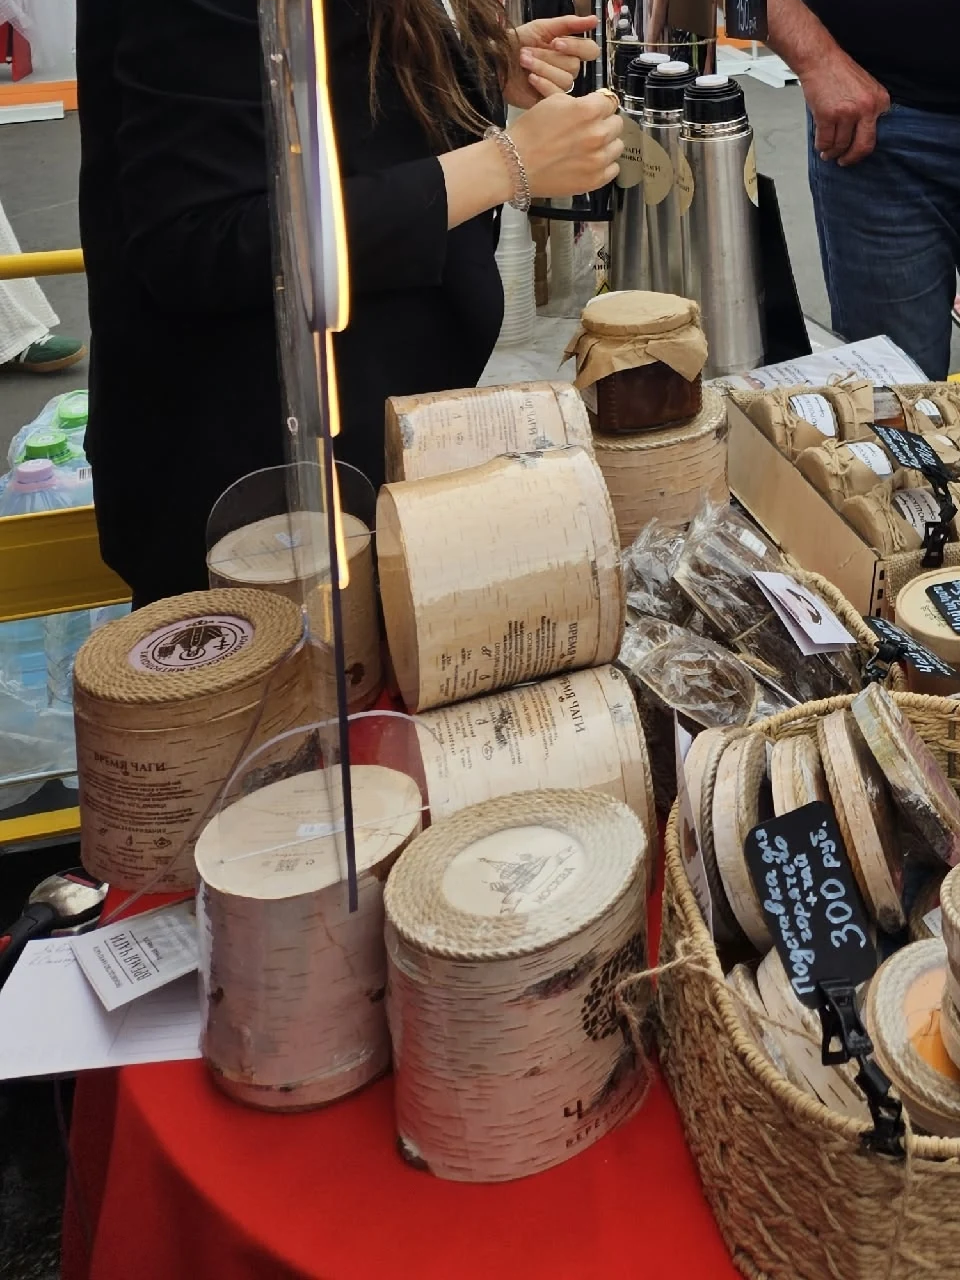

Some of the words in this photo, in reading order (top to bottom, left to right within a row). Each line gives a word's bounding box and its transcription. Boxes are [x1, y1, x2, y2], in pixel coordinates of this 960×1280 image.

[558, 676, 576, 702] РЕМЯ
[568, 700, 586, 734] ЧАГИ
[93, 752, 129, 772] ВРЕМЯ
[130, 760, 166, 773] ЧАГИ
[755, 828, 776, 865] для
[809, 820, 841, 868] руб.
[535, 864, 575, 905] МОСКВА
[774, 835, 813, 943] горячего
[793, 853, 814, 891] чай
[763, 869, 816, 995] Подставка
[820, 878, 867, 949] 300
[109, 933, 134, 958] ЧАГИ
[123, 953, 153, 982] ВРЕМЯ
